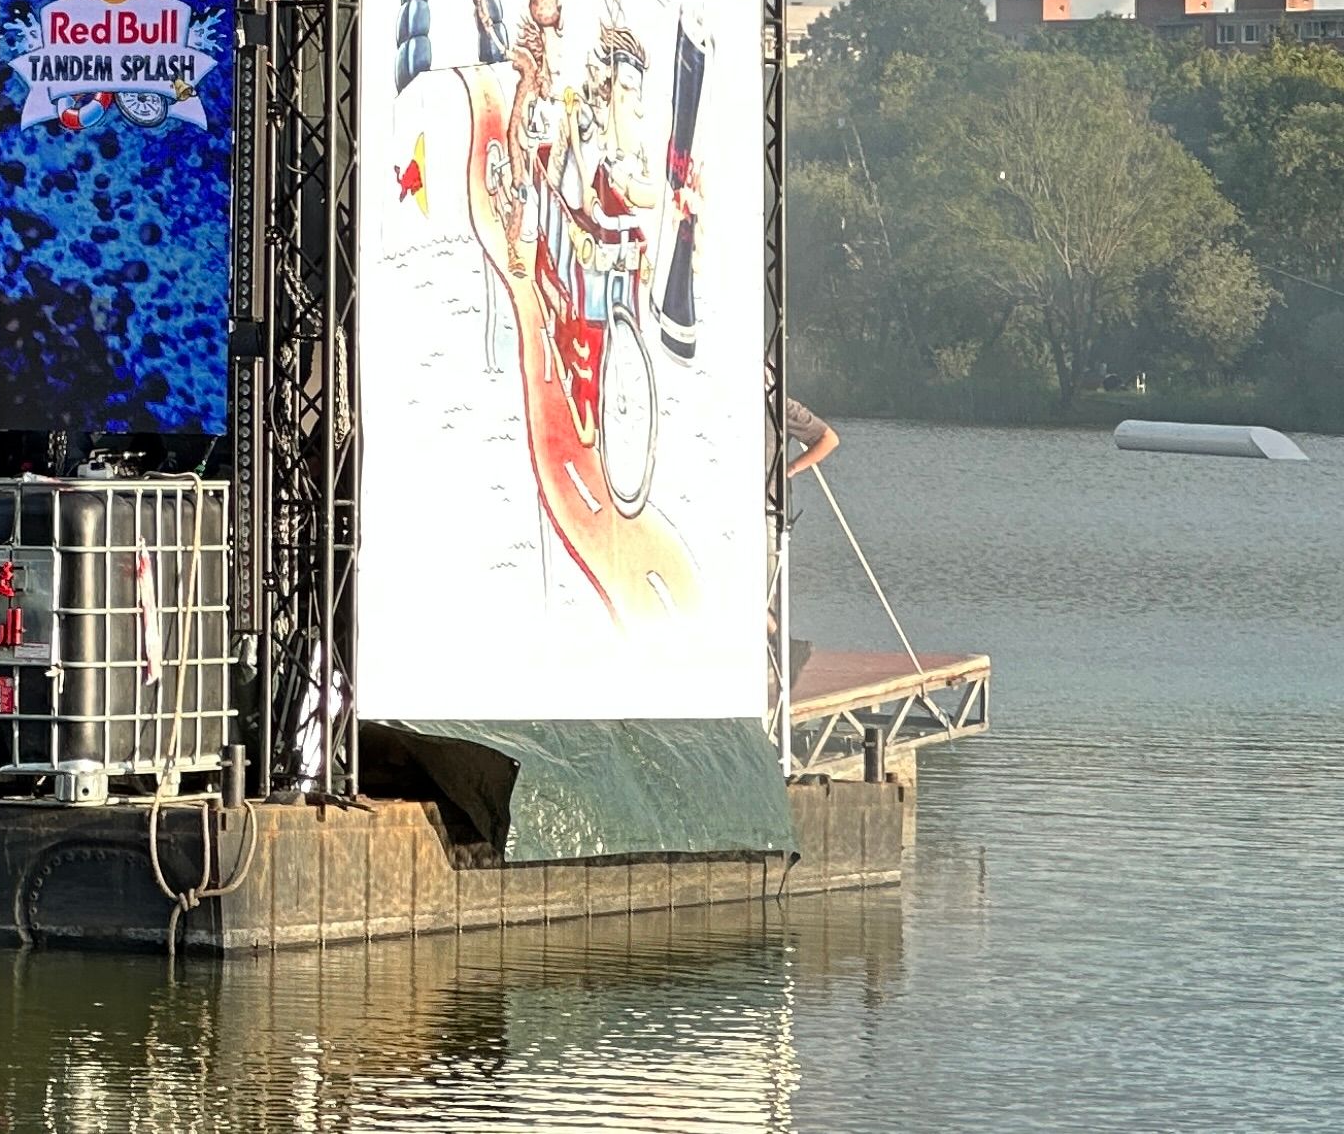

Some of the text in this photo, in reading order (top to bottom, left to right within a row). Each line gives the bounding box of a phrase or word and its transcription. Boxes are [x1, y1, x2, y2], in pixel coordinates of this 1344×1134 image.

[50, 10, 179, 45] Red Bull
[28, 54, 195, 83] TANDEM SPLASH
